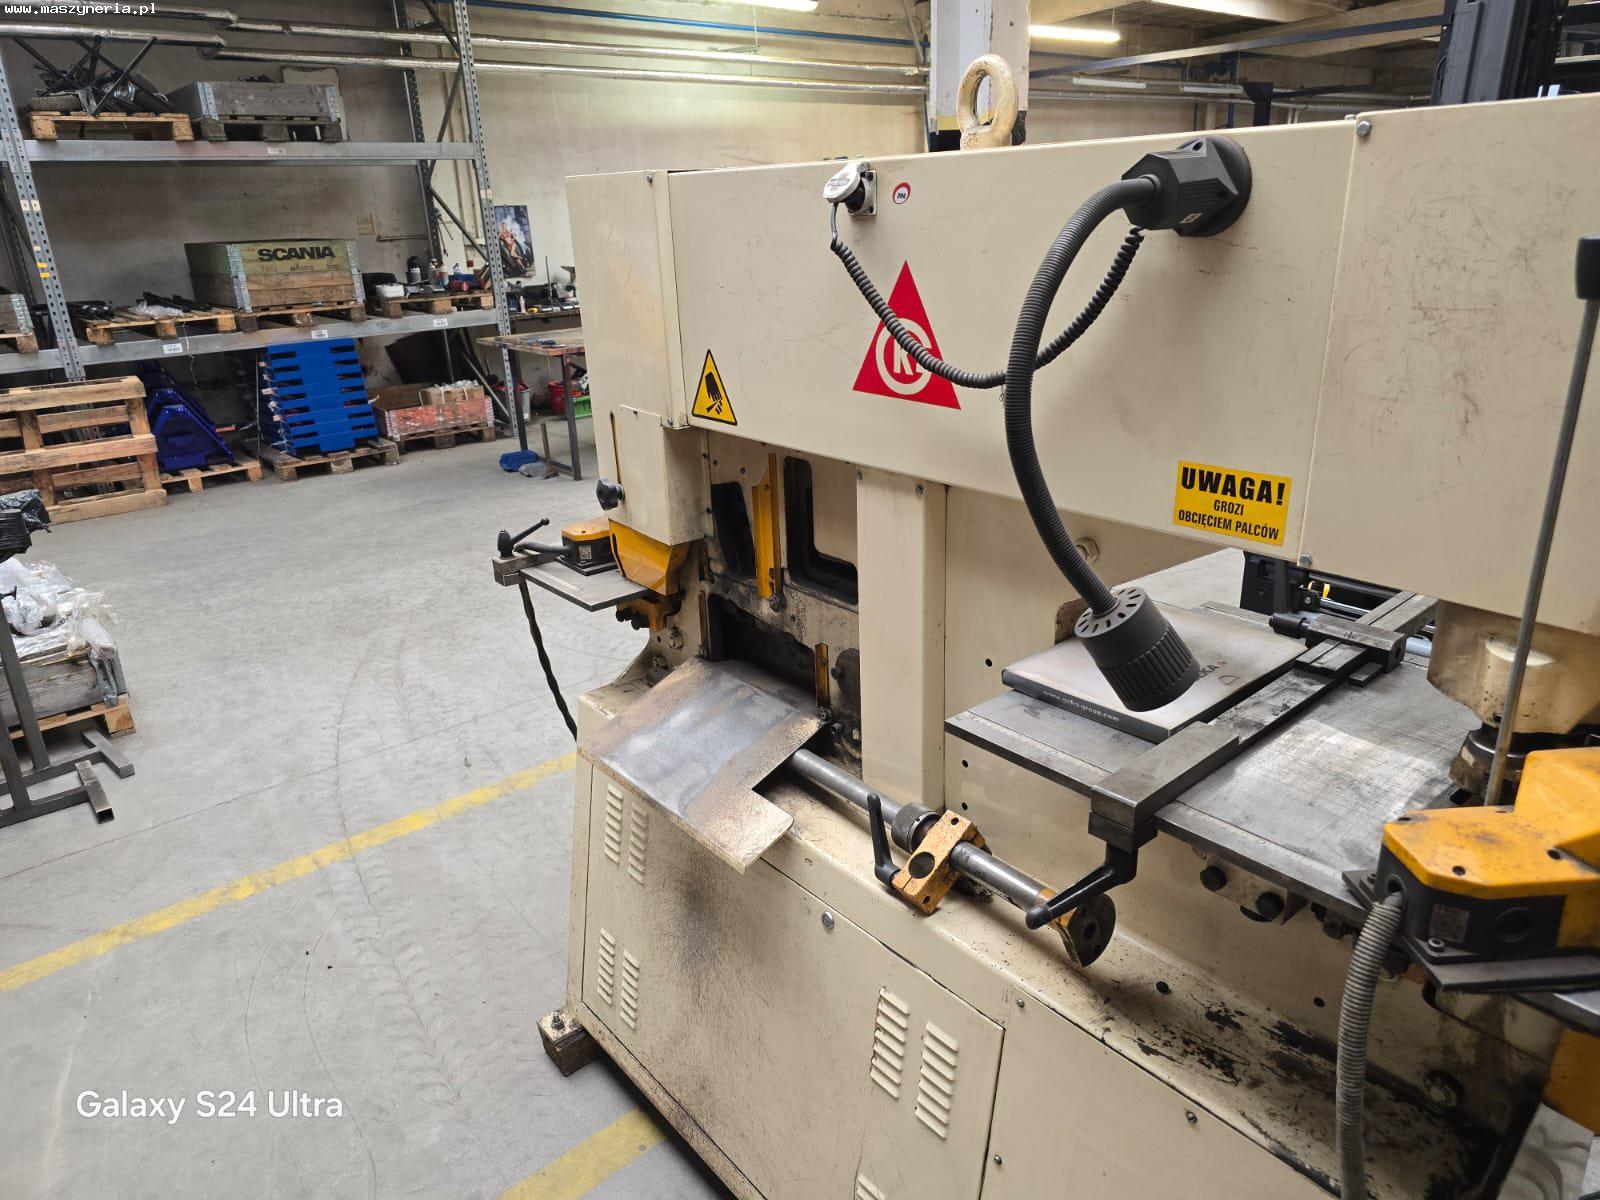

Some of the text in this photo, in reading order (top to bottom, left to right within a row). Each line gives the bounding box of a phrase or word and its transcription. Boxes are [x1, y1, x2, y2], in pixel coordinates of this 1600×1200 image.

[257, 246, 336, 261] SCANIA
[1181, 466, 1286, 506] UWAGA!
[1213, 499, 1245, 516] GROZI
[1178, 509, 1280, 541] OBCIĘCIEM PALCÓW
